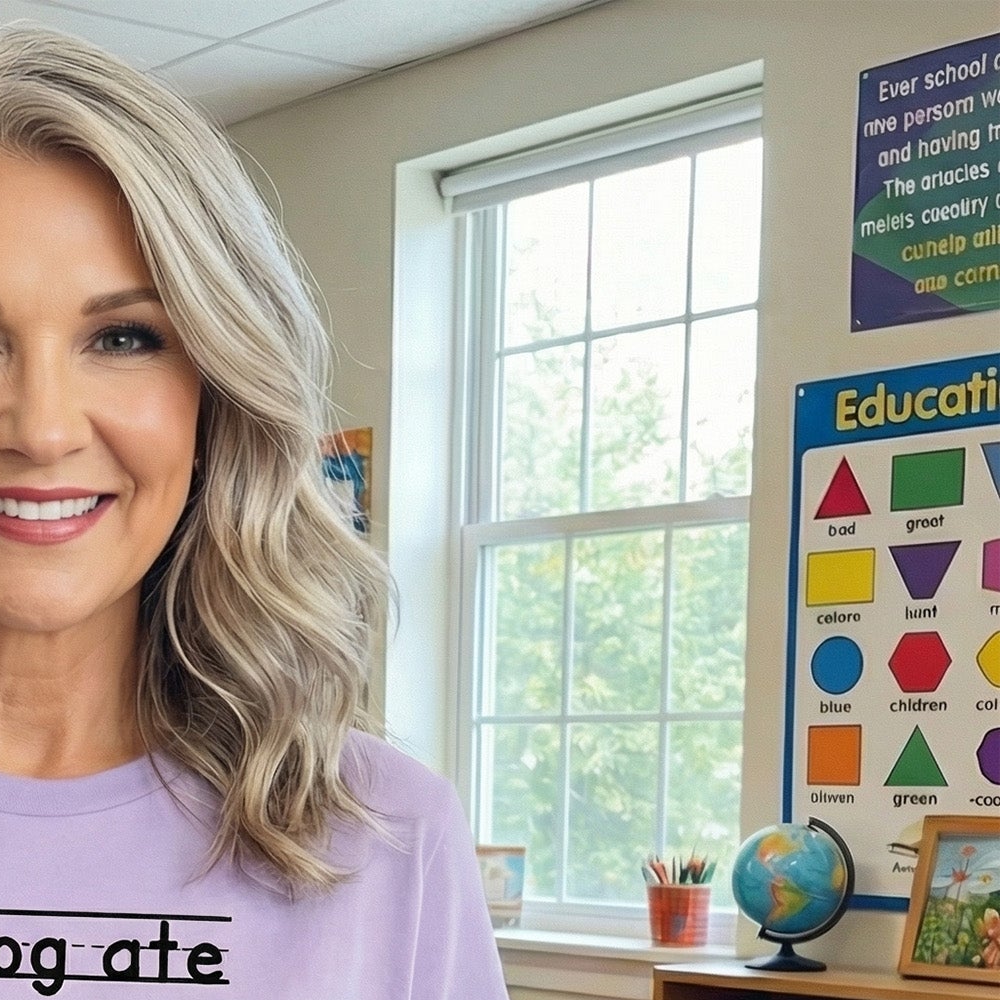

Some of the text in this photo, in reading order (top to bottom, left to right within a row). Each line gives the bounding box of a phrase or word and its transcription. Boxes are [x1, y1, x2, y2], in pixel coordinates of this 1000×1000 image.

[879, 76, 919, 102] Ever
[924, 53, 988, 90] school
[878, 141, 911, 167] and
[883, 177, 916, 199] The
[836, 367, 997, 432] Educati
[828, 522, 856, 537] bad
[819, 700, 852, 714] blue
[893, 793, 938, 808] green
[101, 920, 225, 983] ate
